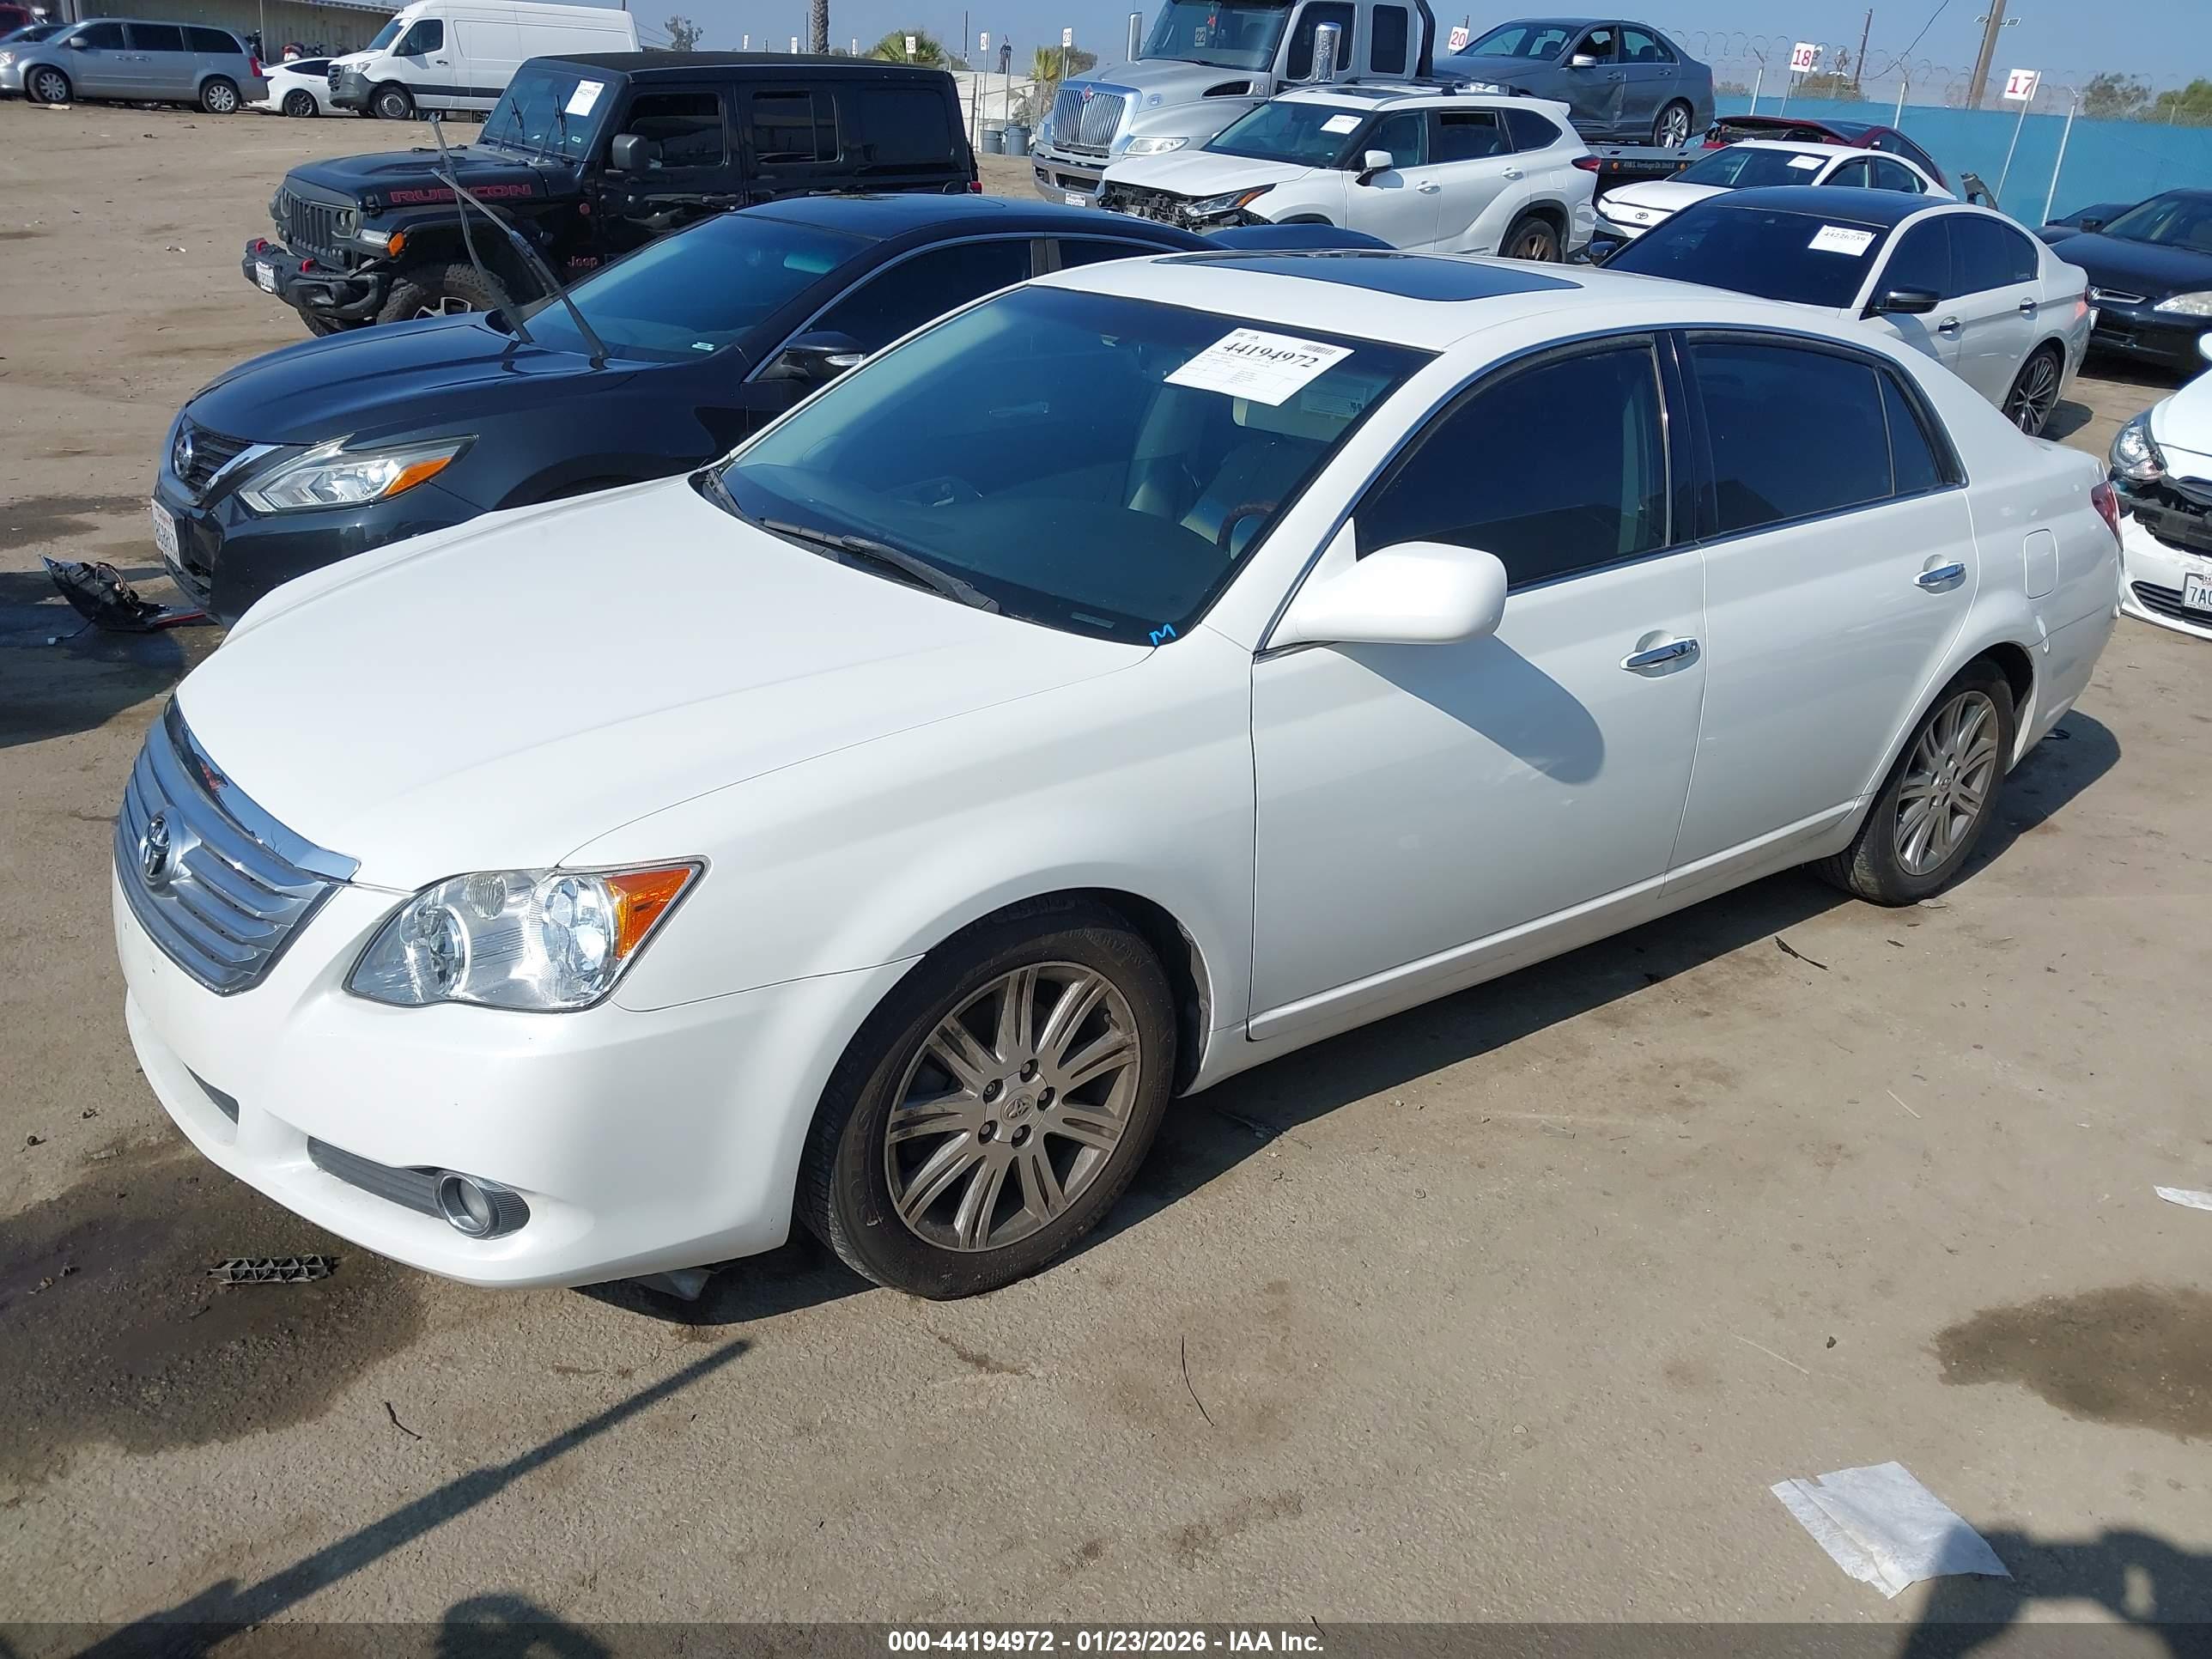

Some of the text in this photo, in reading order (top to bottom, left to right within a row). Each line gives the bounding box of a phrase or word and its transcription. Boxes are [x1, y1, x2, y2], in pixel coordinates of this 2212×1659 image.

[1196, 31, 1205, 42] 22
[1450, 31, 1467, 46] 20
[1792, 49, 1812, 66] 18
[2007, 76, 2033, 94] 17
[389, 184, 532, 203] RUBCON
[567, 255, 598, 269] Jeep
[1223, 341, 1320, 368] 44194972
[1148, 623, 1176, 646] M
